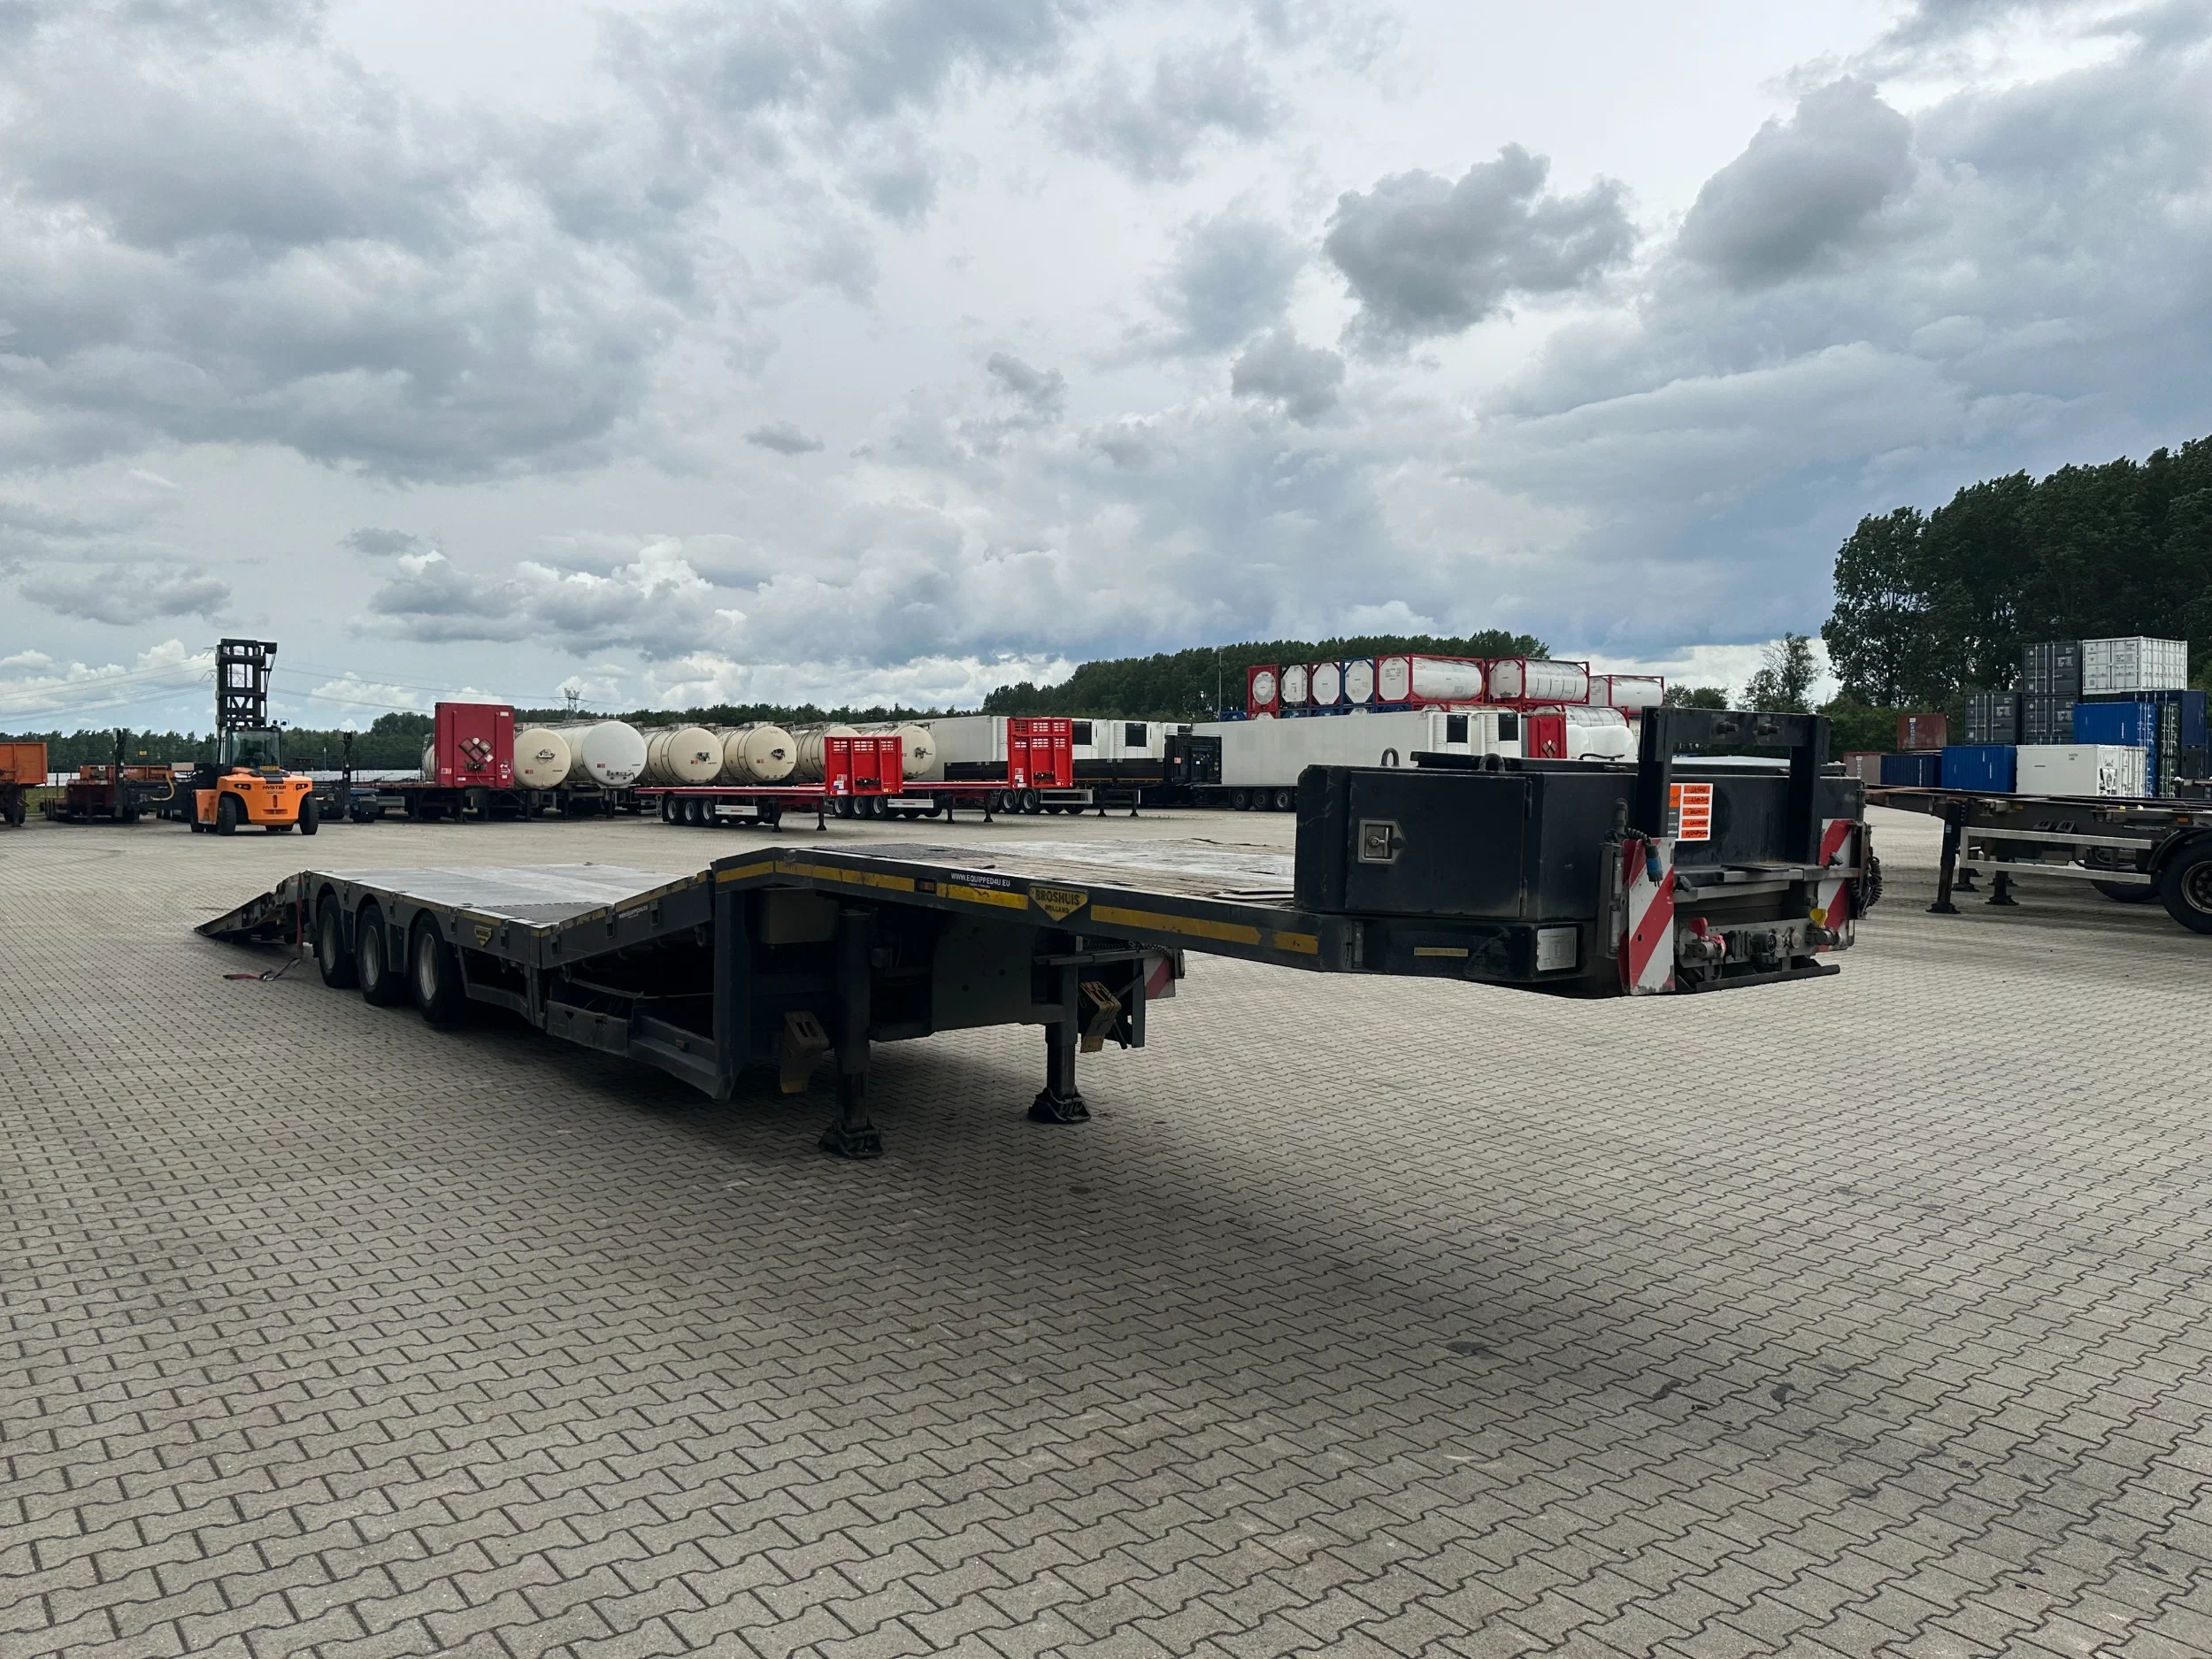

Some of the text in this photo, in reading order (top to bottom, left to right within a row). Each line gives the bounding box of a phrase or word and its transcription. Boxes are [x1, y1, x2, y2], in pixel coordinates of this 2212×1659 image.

[950, 872, 1010, 887] WWW.EQUIPPED4U.EU
[1035, 889, 1079, 905] BROSHUIS
[1044, 904, 1070, 914] HOLLAND
